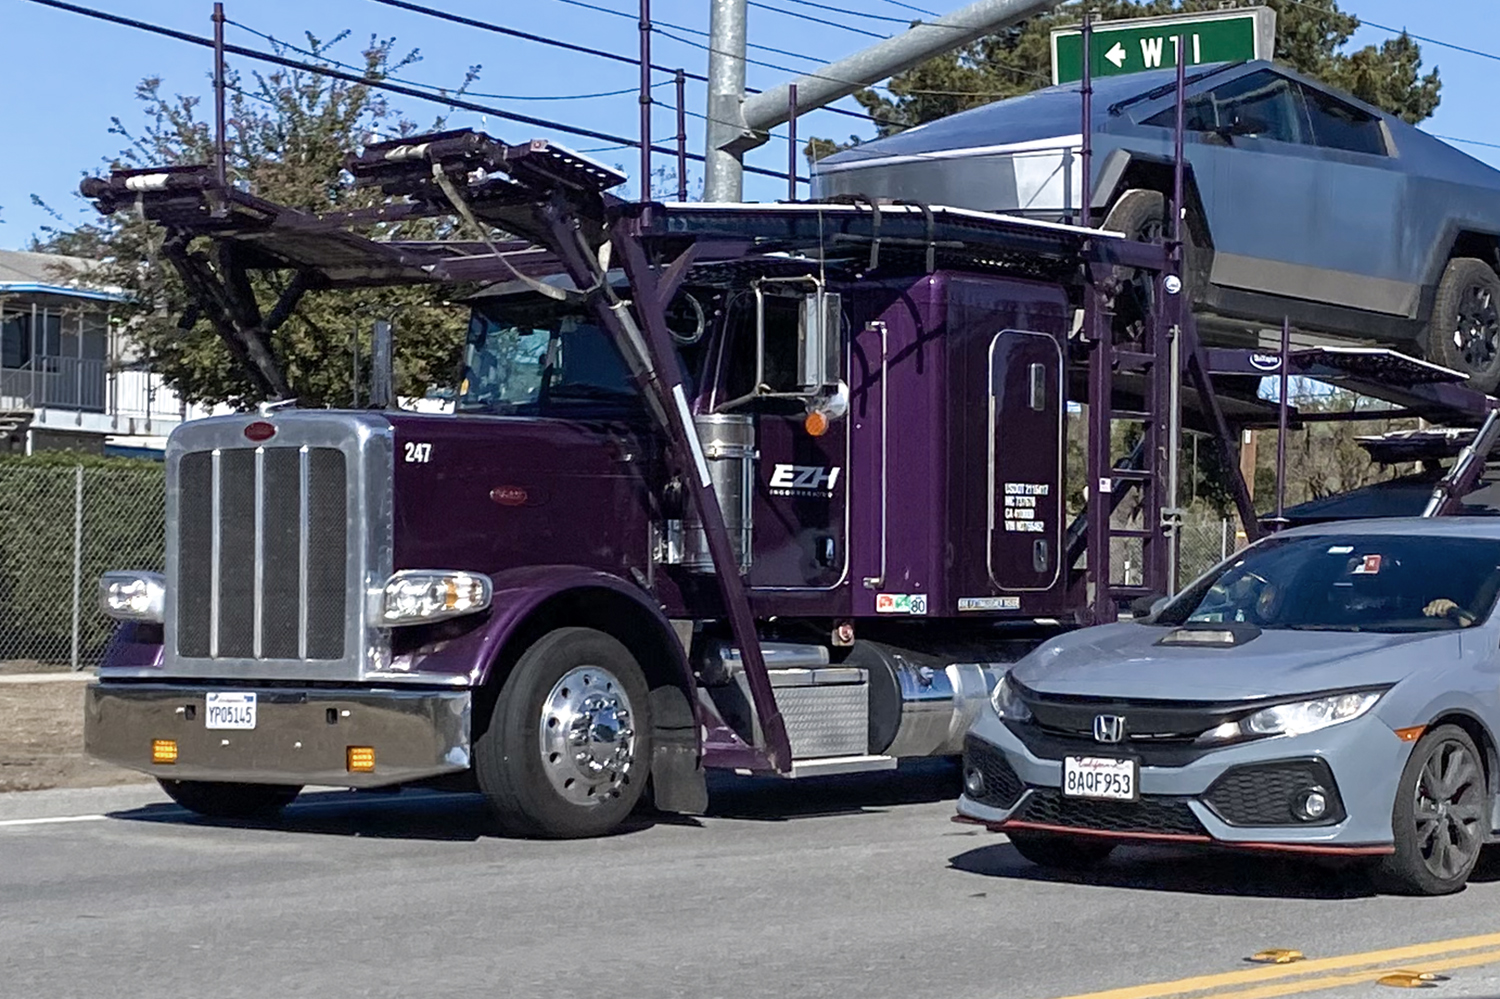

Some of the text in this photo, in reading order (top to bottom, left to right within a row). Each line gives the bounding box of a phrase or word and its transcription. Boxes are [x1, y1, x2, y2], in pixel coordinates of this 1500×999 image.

[405, 442, 432, 463] 247
[769, 464, 841, 490] EZH
[911, 599, 925, 613] 80
[209, 706, 253, 725] YP05145
[1068, 770, 1130, 794] 8AQF953
